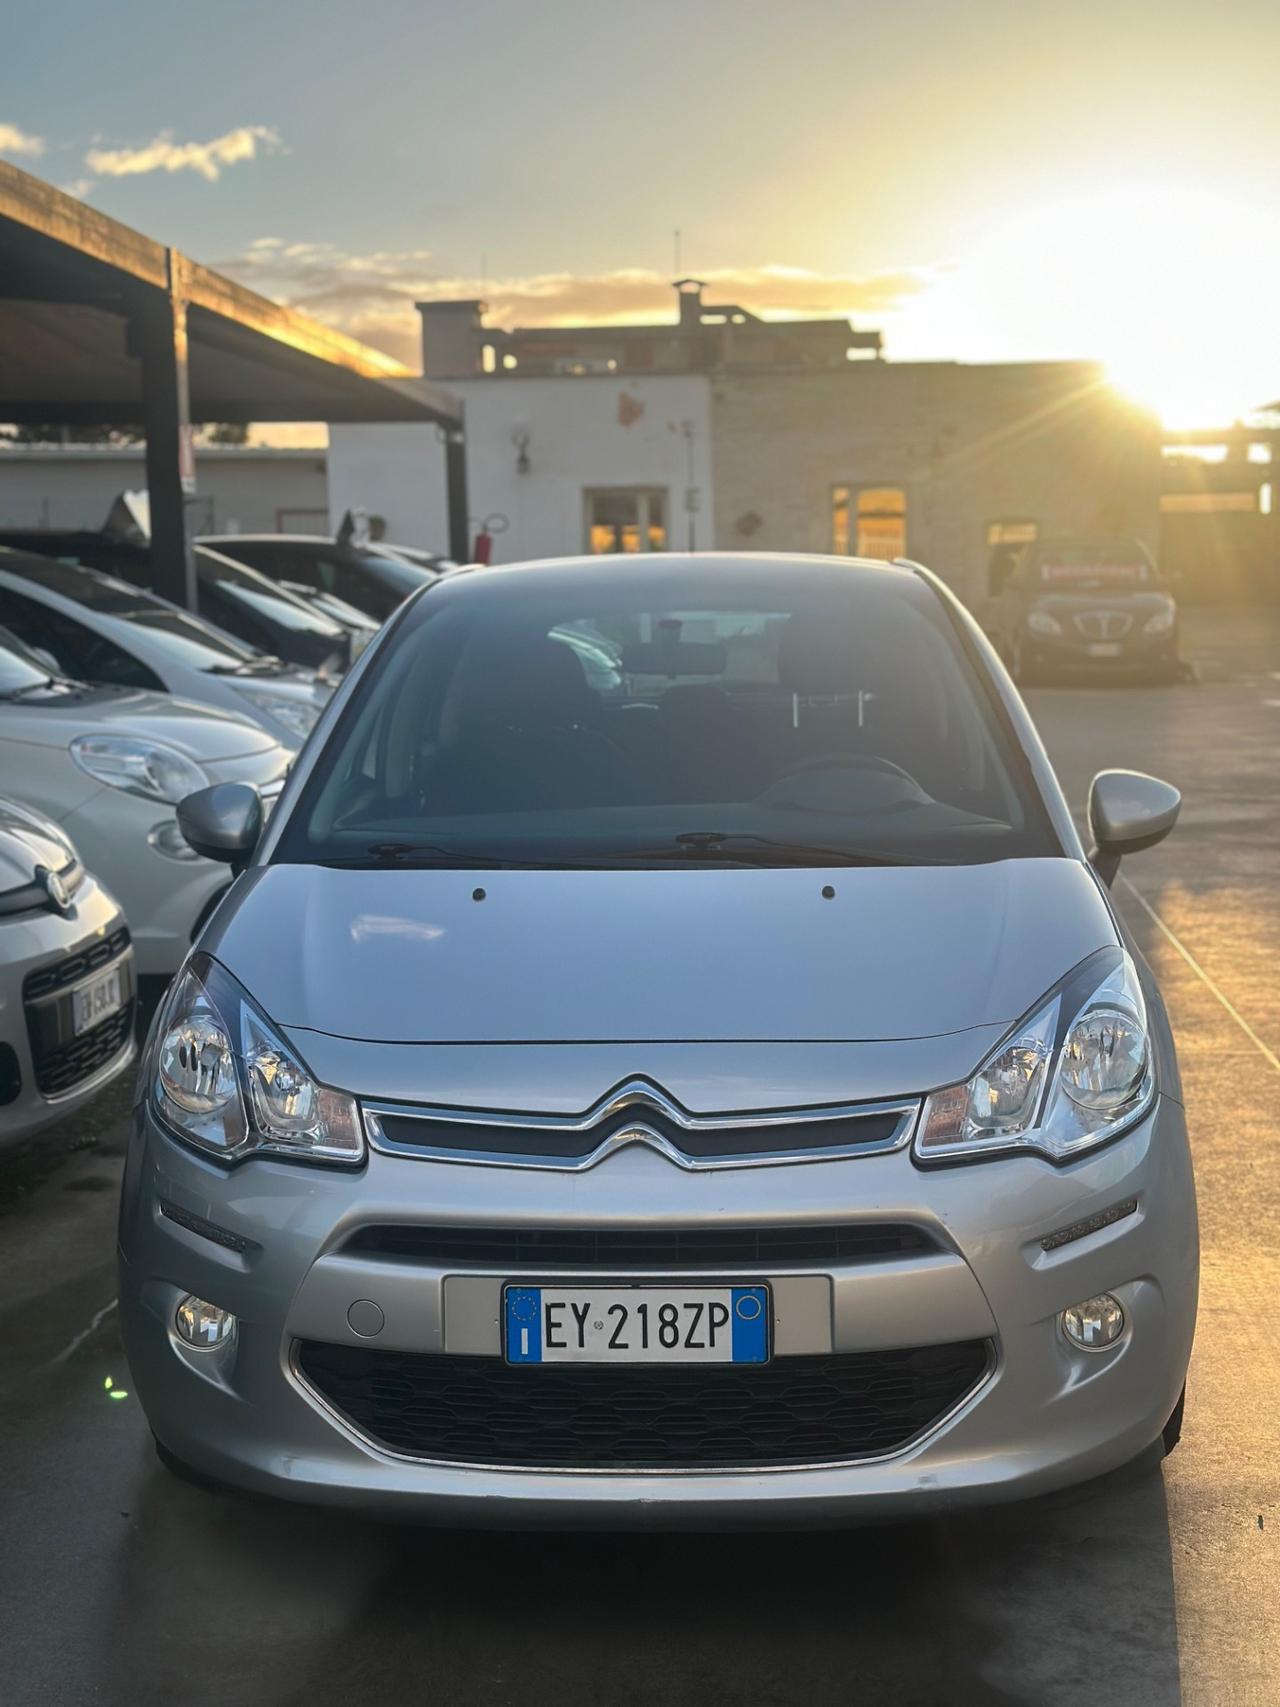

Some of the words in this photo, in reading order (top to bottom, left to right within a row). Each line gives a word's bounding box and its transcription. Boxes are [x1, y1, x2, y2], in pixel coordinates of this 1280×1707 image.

[521, 1328, 529, 1354] I
[545, 1302, 591, 1348] EY
[607, 1303, 730, 1349] 218ZP
